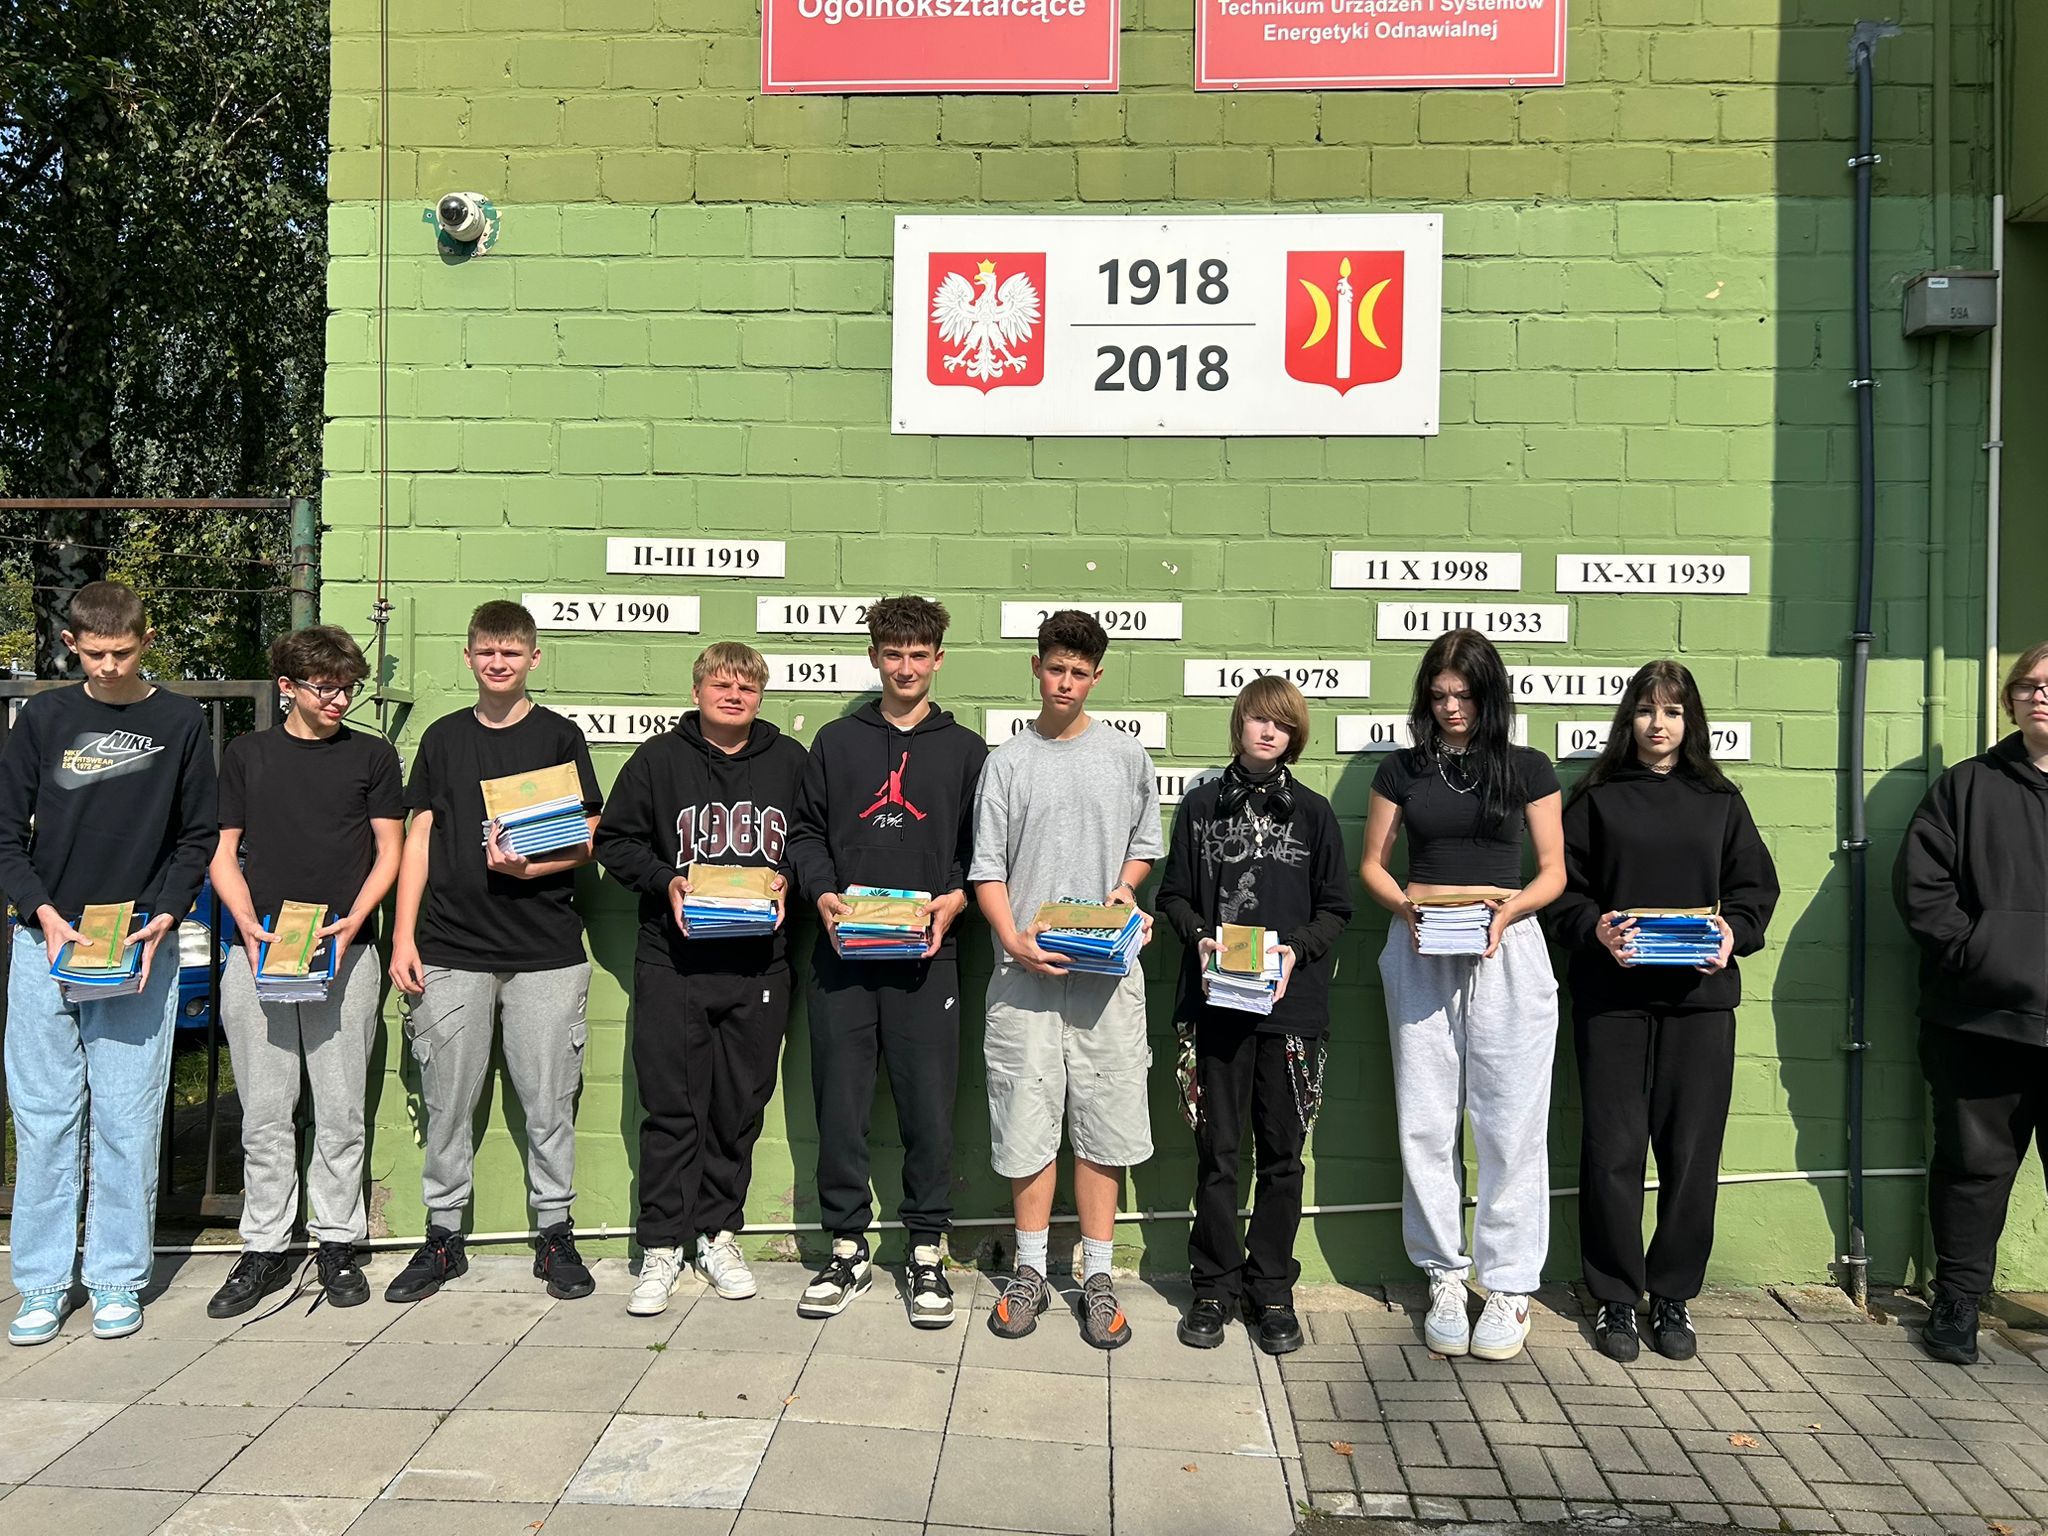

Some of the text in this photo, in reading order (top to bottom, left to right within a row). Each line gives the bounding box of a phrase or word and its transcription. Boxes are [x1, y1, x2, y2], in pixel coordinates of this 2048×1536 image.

[1263, 20, 1498, 44] Energetyki Odnawialnej
[1098, 258, 1229, 305] 1918
[1094, 345, 1229, 391] 2018
[633, 546, 761, 569] II-III 1919
[1366, 559, 1488, 581] 11 X 1998
[1581, 562, 1726, 584] IX-XI 1939
[552, 601, 669, 623] 25 V 1990
[784, 604, 809, 624] 10
[818, 604, 847, 624] IV
[1403, 610, 1542, 632] 01 III 1933
[786, 662, 838, 683] 1931
[1217, 668, 1244, 688] 16
[1542, 674, 1587, 695] VII
[587, 714, 616, 734] XI
[1370, 723, 1396, 743] 01
[101, 730, 153, 751] NIKE
